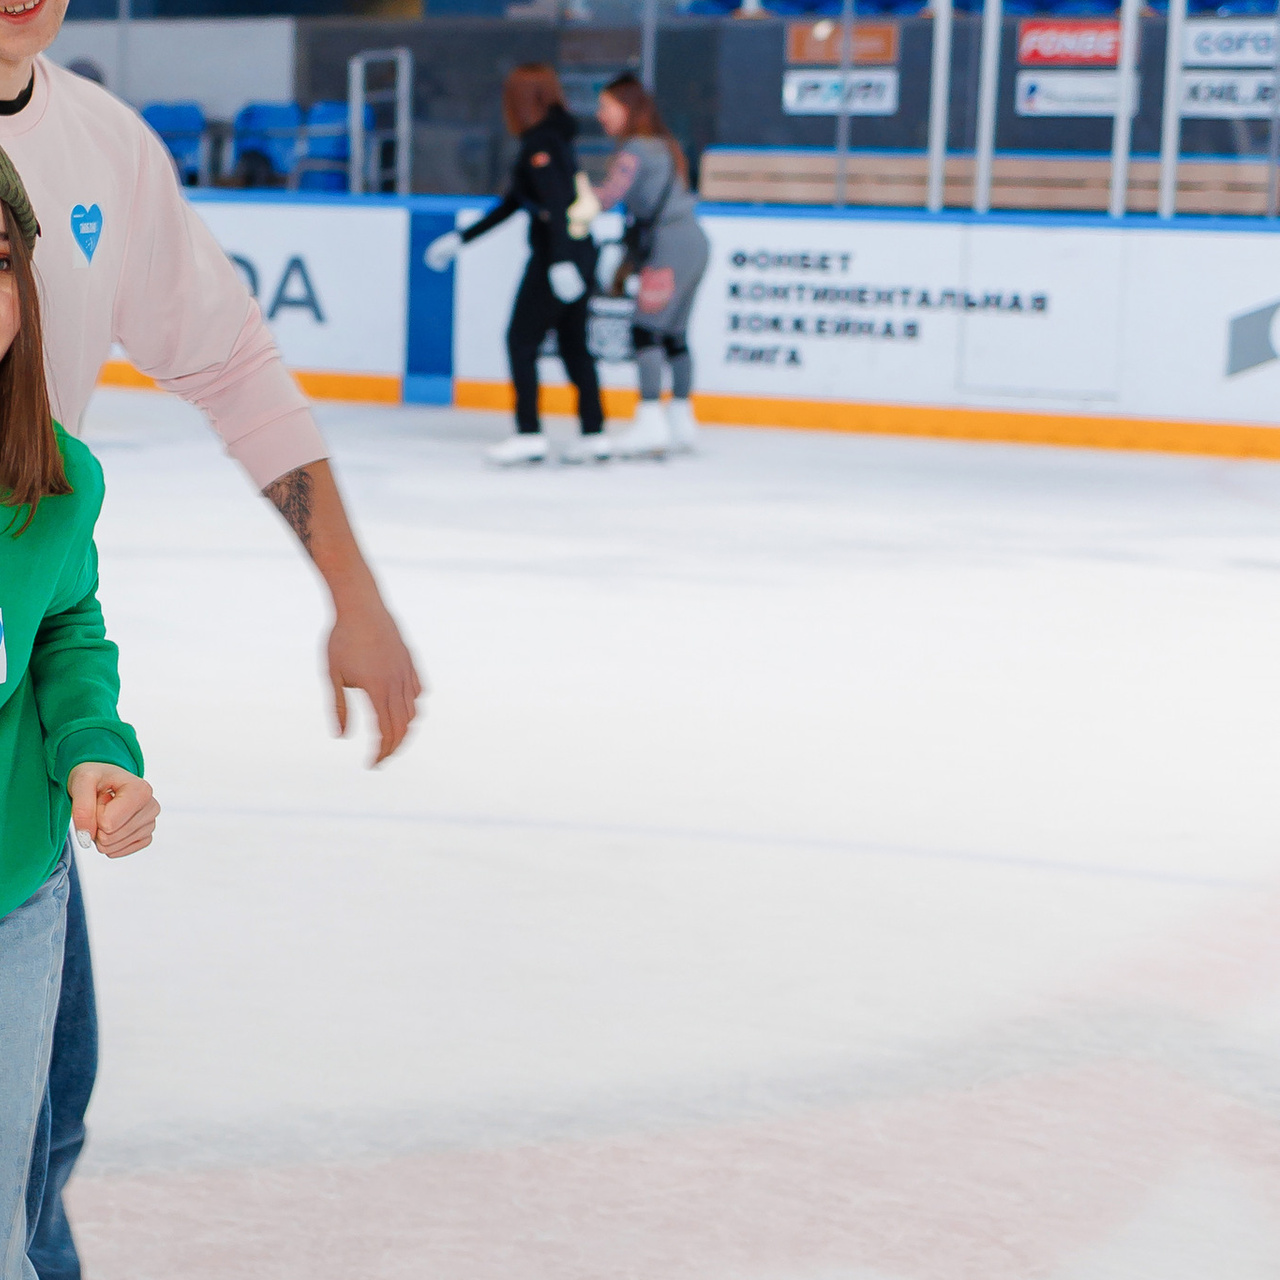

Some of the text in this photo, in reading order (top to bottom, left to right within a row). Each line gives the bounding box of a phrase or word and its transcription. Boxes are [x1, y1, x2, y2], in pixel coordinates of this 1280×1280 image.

[1023, 29, 1119, 58] FONBE
[731, 252, 852, 271] ФОНБЕТ
[729, 283, 1047, 312] КОНТИНЕНТАЛЬНАЯ
[729, 315, 918, 337] ХОККЕЙНАЯ
[726, 345, 802, 365] ЛИГА
